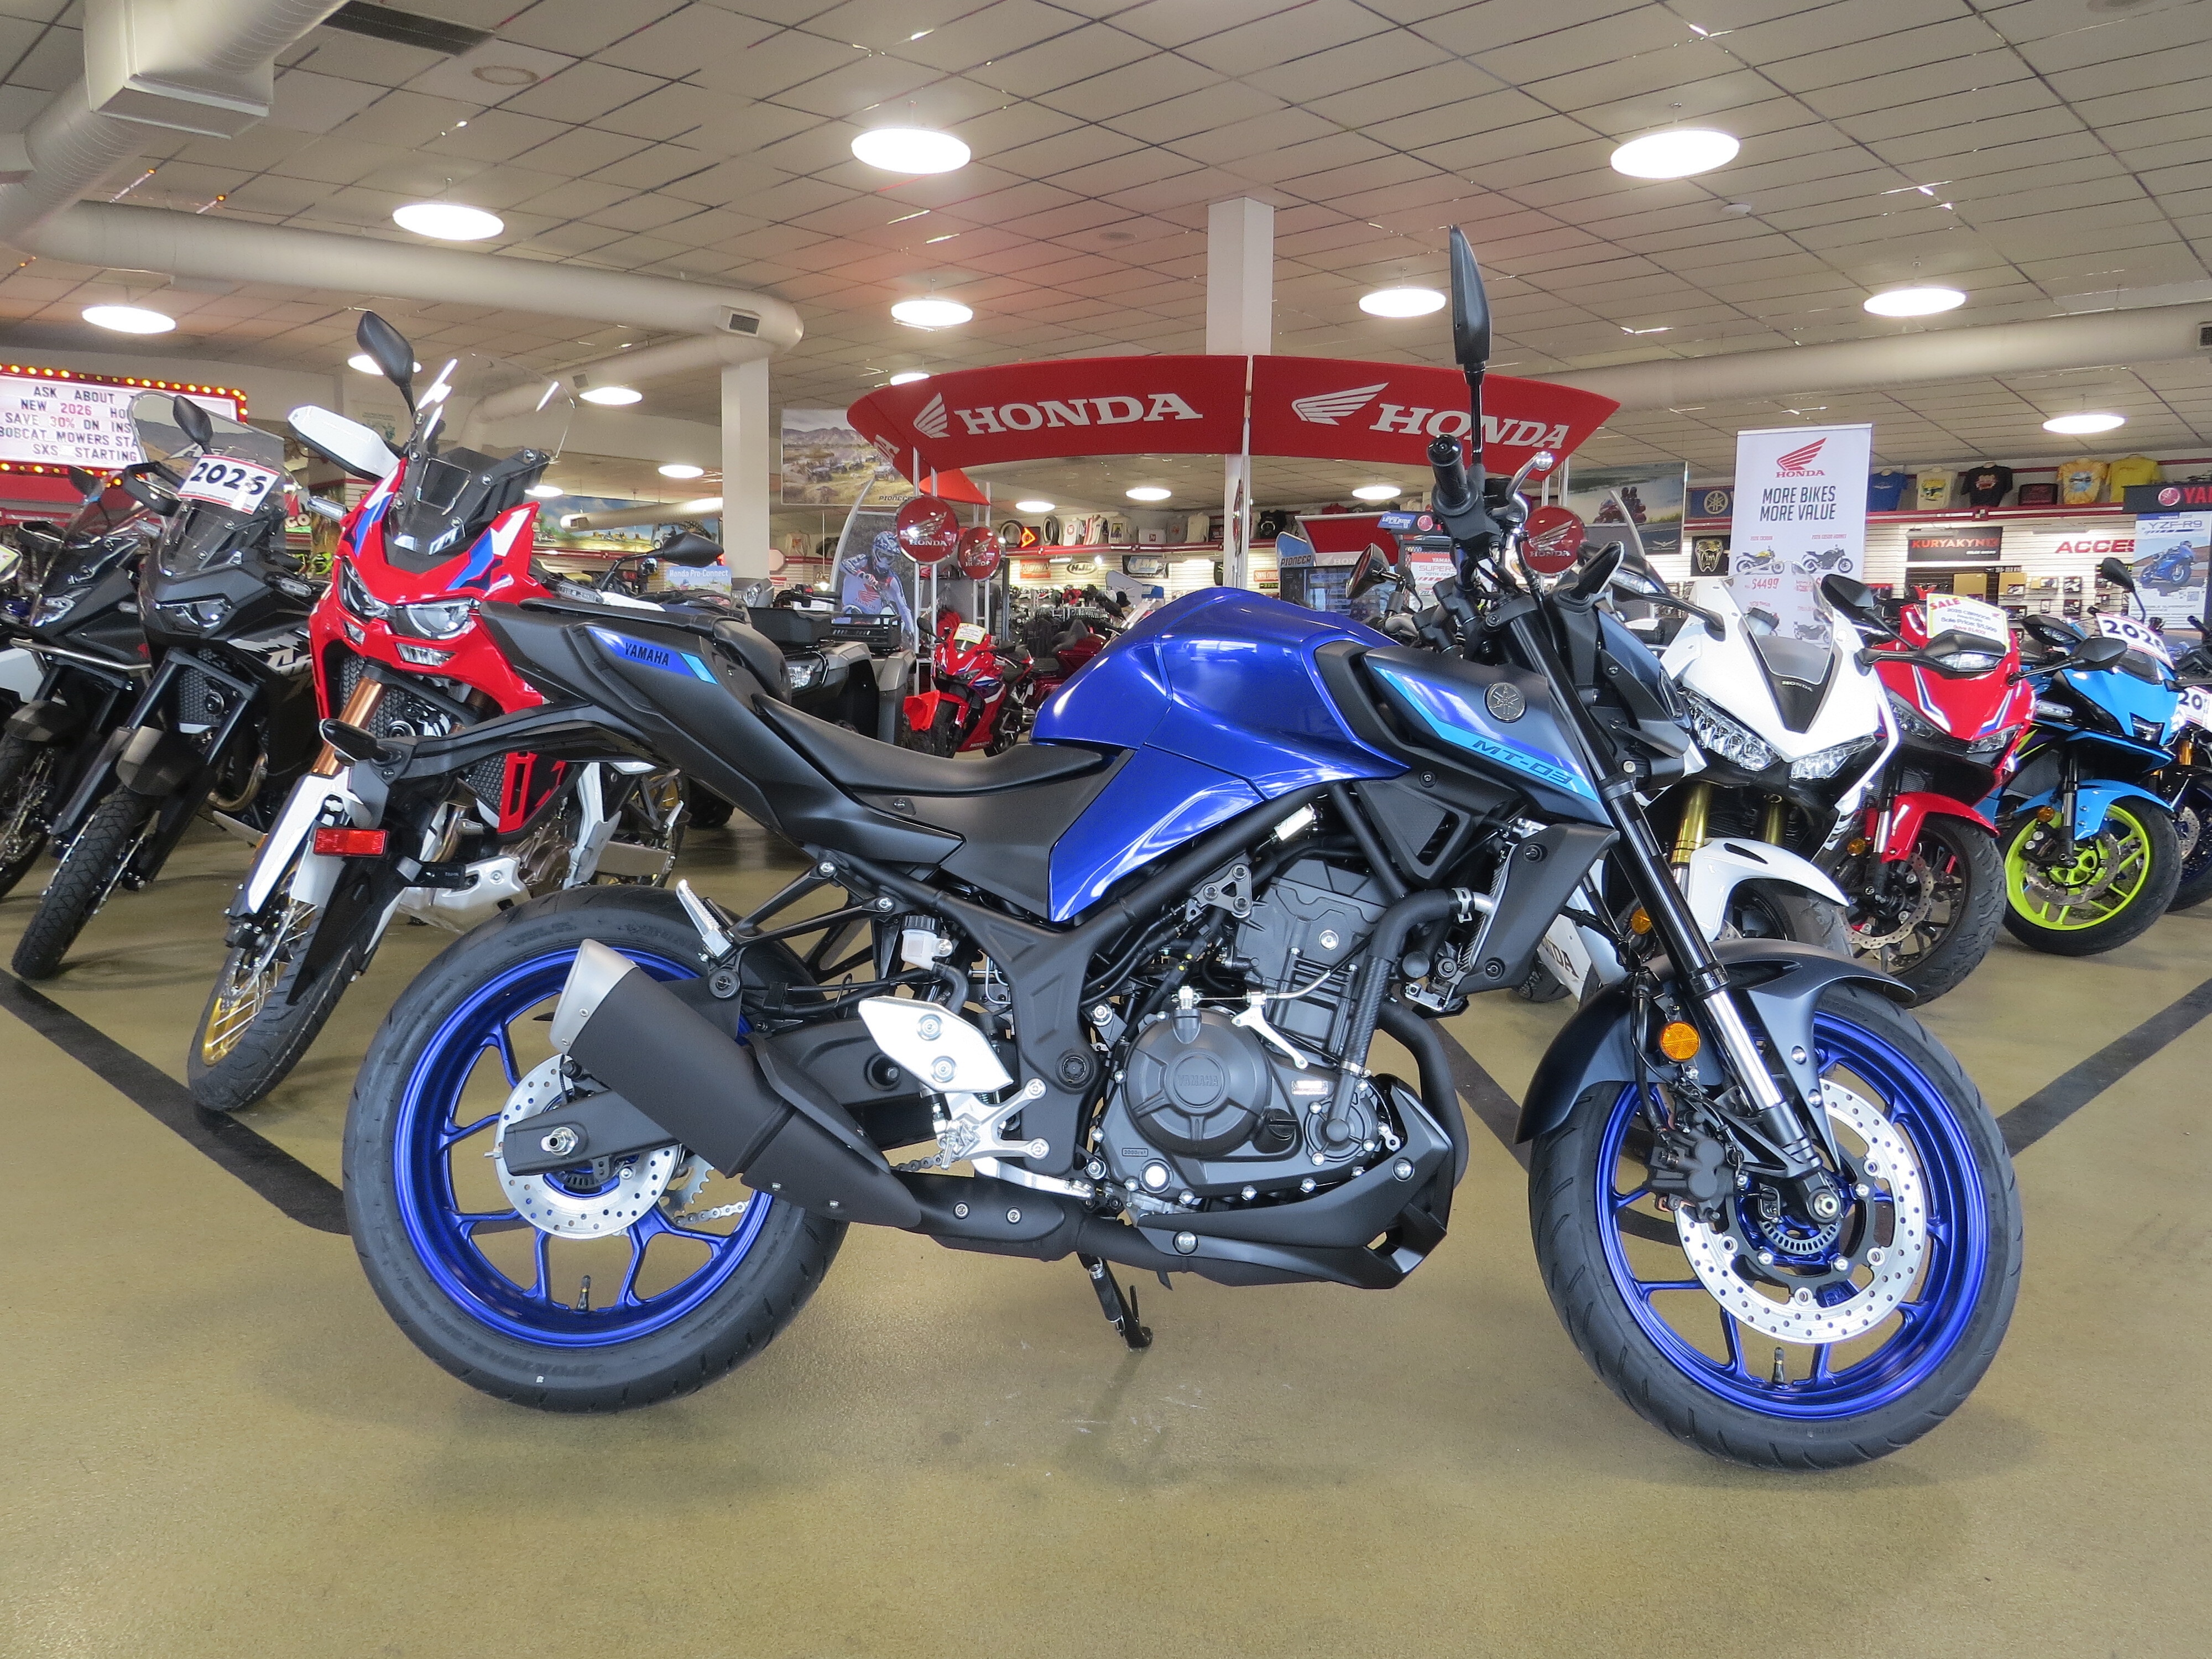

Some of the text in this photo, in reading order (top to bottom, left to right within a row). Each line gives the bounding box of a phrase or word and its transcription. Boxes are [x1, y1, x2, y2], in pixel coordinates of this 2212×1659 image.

[34, 387, 57, 398] ASK
[74, 390, 115, 404] ABOUT
[20, 399, 129, 419] NEW 2026 HO
[954, 393, 1203, 435] HONDA
[5, 412, 39, 425] SAVE
[50, 416, 75, 429] 30%
[84, 419, 100, 430] ON
[1369, 404, 1569, 449] HONDA
[0, 426, 46, 439] BOBCAT
[56, 431, 109, 445] MOWERS
[33, 444, 137, 462] SXS STARTING
[1762, 486, 1836, 504] MORE BIKES
[1760, 503, 1837, 521] MORE VALUE
[2148, 520, 2202, 529] YZF-R9
[1912, 539, 1988, 548] KURYAKYN
[2055, 539, 2135, 554] ACCES
[1281, 555, 1311, 566] PIONEER
[691, 569, 728, 577] Pro-Connect
[1929, 598, 1961, 611] SALE
[625, 643, 670, 666] YAMAHA
[1782, 681, 1813, 692] HONDA
[2178, 690, 2205, 711] 20
[1473, 740, 1573, 784] MT-03
[1178, 1075, 1219, 1086] YAMAHA
